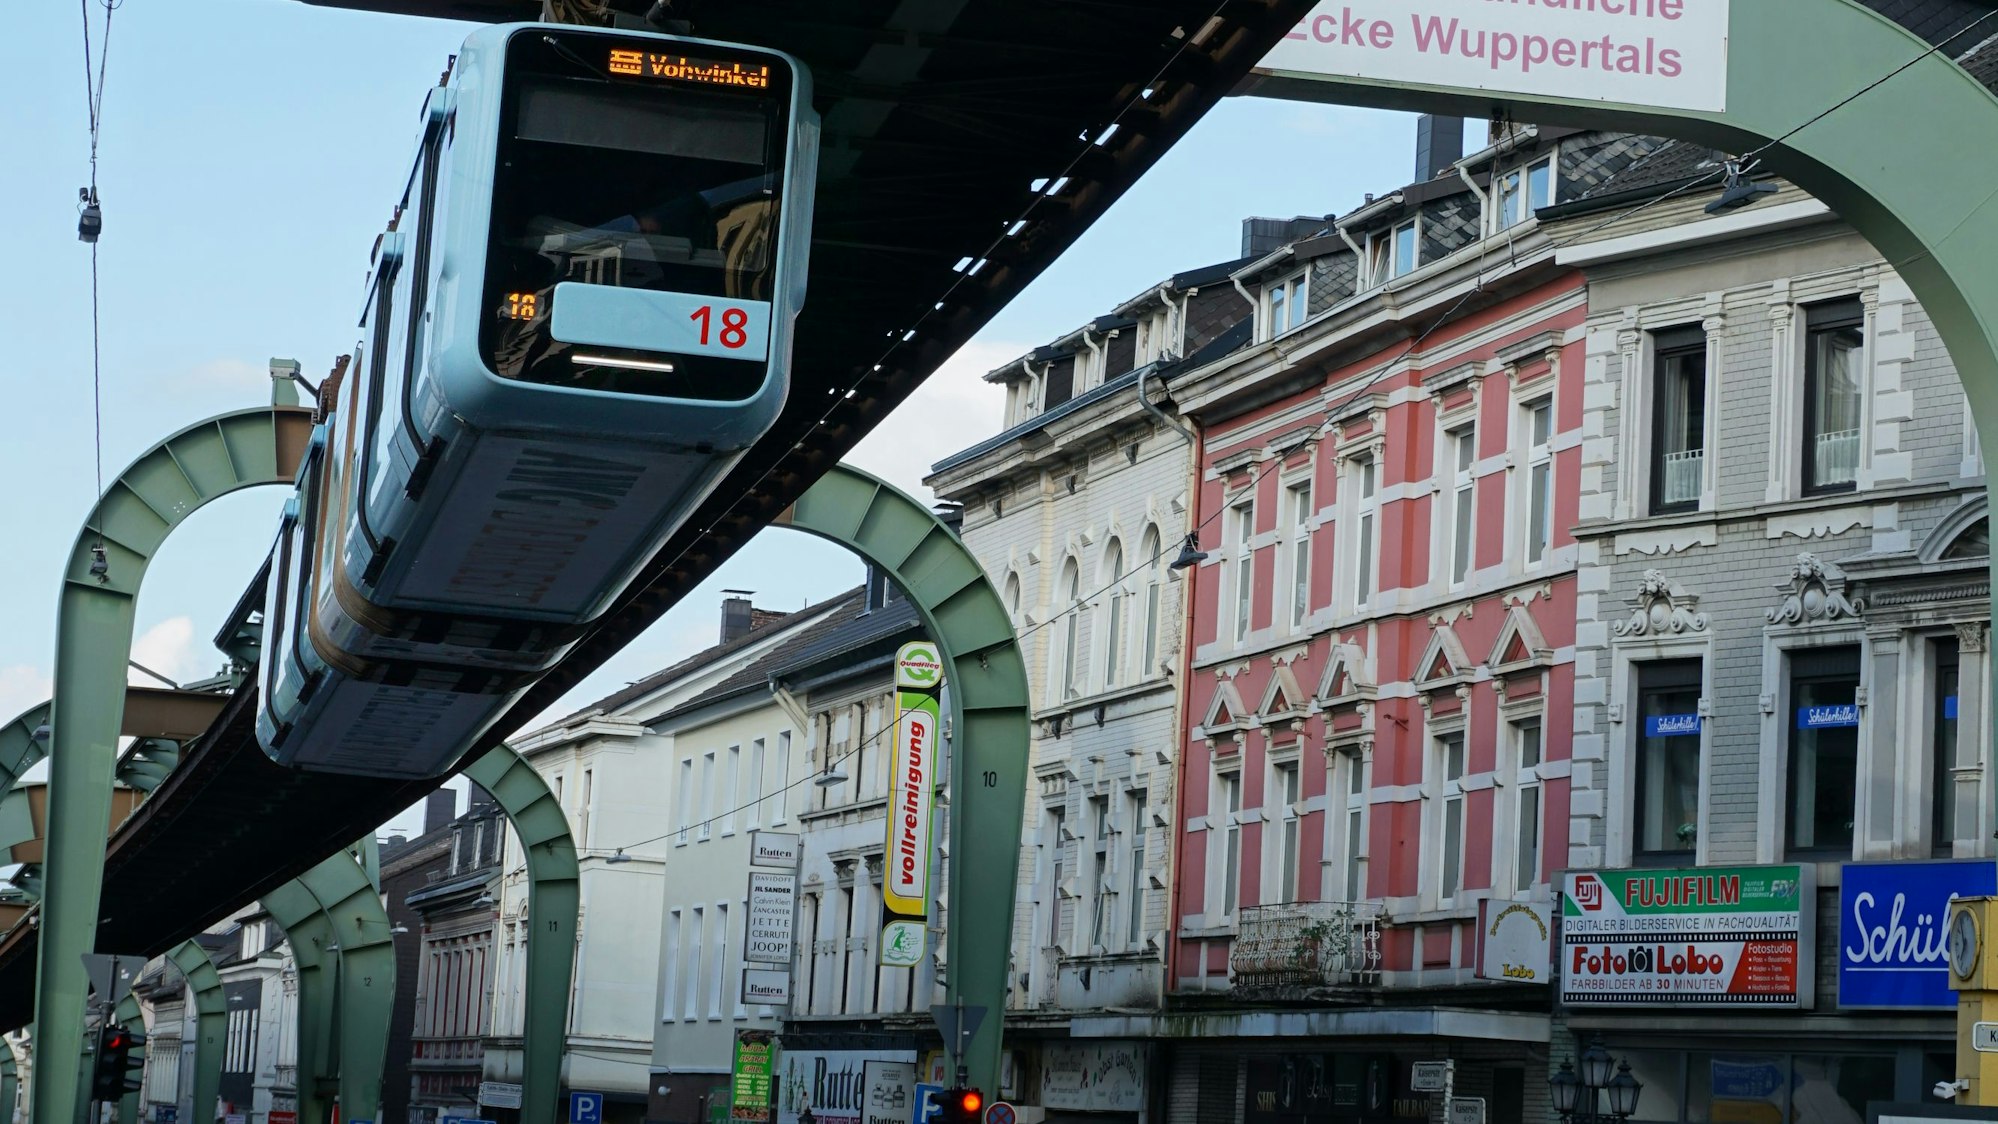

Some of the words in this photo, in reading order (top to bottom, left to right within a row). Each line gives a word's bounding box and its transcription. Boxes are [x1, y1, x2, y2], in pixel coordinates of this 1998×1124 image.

[1411, 14, 1682, 77] Wuppertals
[650, 54, 767, 88] Vohwinkel
[508, 293, 535, 321] 18
[690, 306, 748, 349] 18
[983, 771, 997, 787] 10
[901, 721, 925, 885] vollreinigung
[760, 847, 791, 858] Rutten
[755, 875, 791, 883] DAVIDOFF
[1624, 875, 1740, 908] FUJIFILM
[753, 896, 775, 905] Calvin
[776, 897, 790, 906] Klein
[548, 920, 558, 932] 11
[752, 917, 789, 927] JETTE
[1565, 920, 1617, 931] DIGITALER
[1619, 918, 1700, 931] BILDERSERVICE
[1704, 917, 1715, 929] IN
[1717, 914, 1798, 929] FACHQUALITÄT
[752, 930, 789, 939] CERRUTI
[751, 941, 788, 953] JOOP!
[1748, 943, 1793, 954] Fotostudio
[1572, 946, 1627, 975] Foto
[1656, 945, 1724, 975] Lobo
[1502, 964, 1535, 979] Lobo
[363, 977, 372, 987] 12
[1571, 978, 1636, 990] FARBBILDER
[1639, 978, 1652, 990] AB
[1656, 978, 1670, 990] 30
[1674, 978, 1724, 990] MINUTEN
[750, 984, 783, 994] Rutten
[577, 1097, 595, 1121] P
